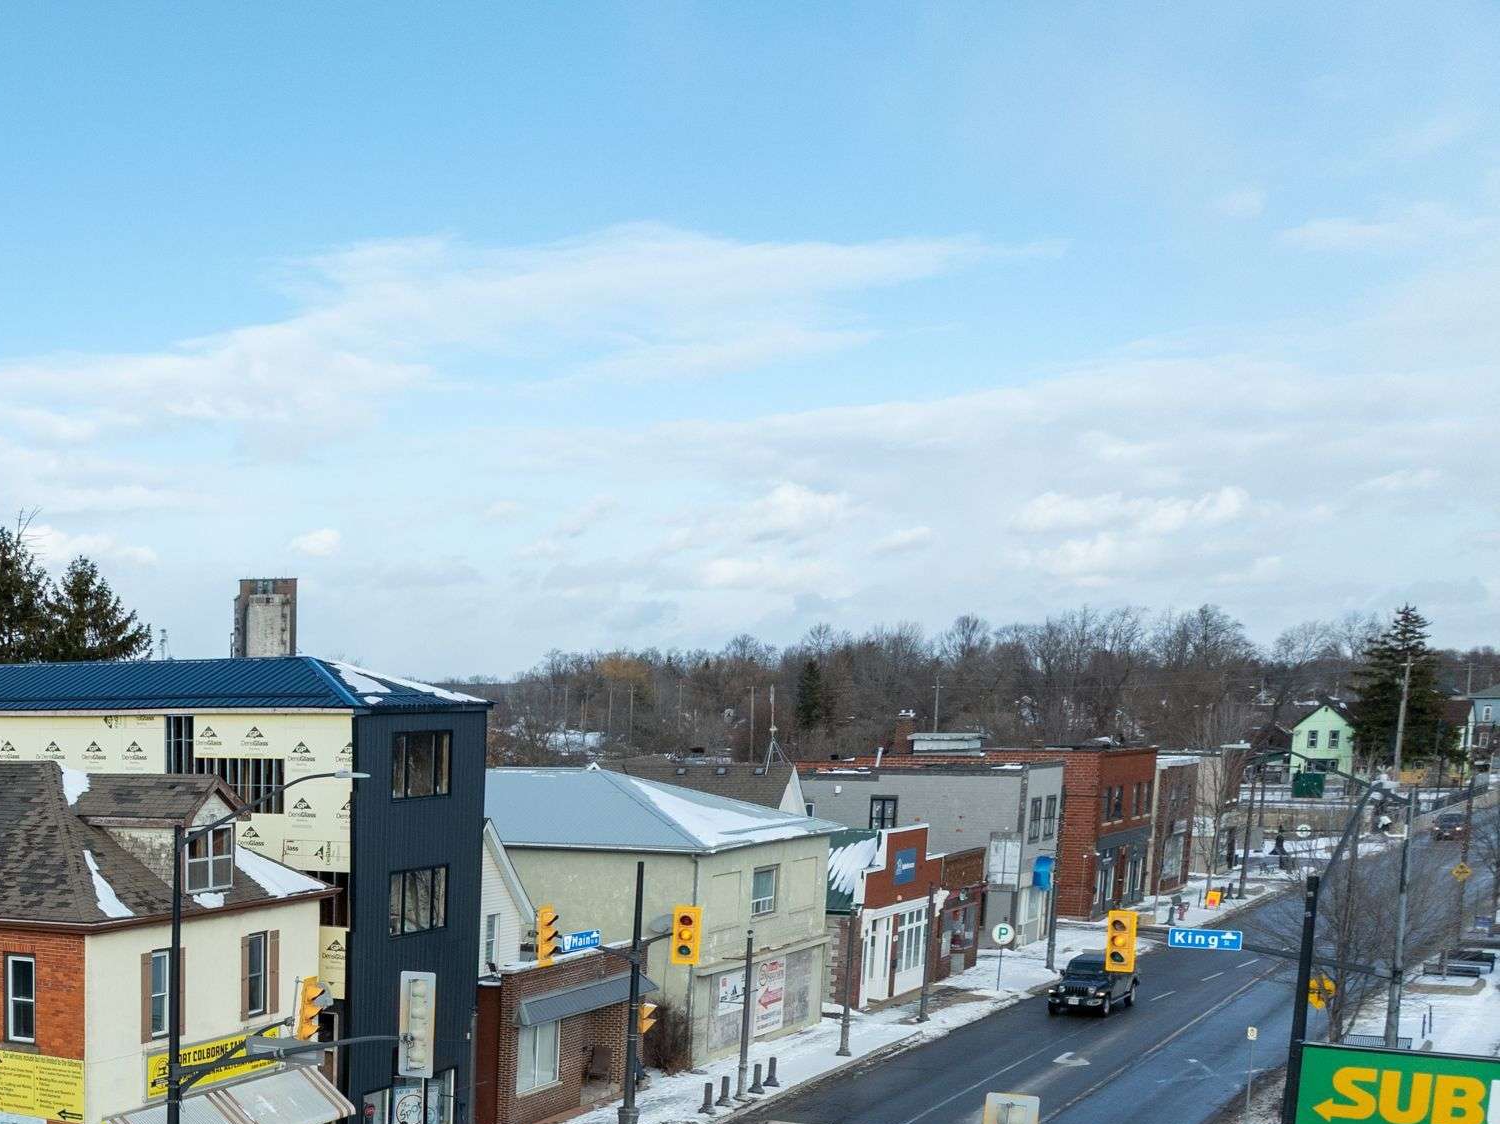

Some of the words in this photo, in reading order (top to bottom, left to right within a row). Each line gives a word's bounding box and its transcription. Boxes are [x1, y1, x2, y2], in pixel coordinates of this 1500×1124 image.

[999, 928, 1008, 939] P
[1174, 931, 1218, 949] King
[572, 935, 590, 948] Main
